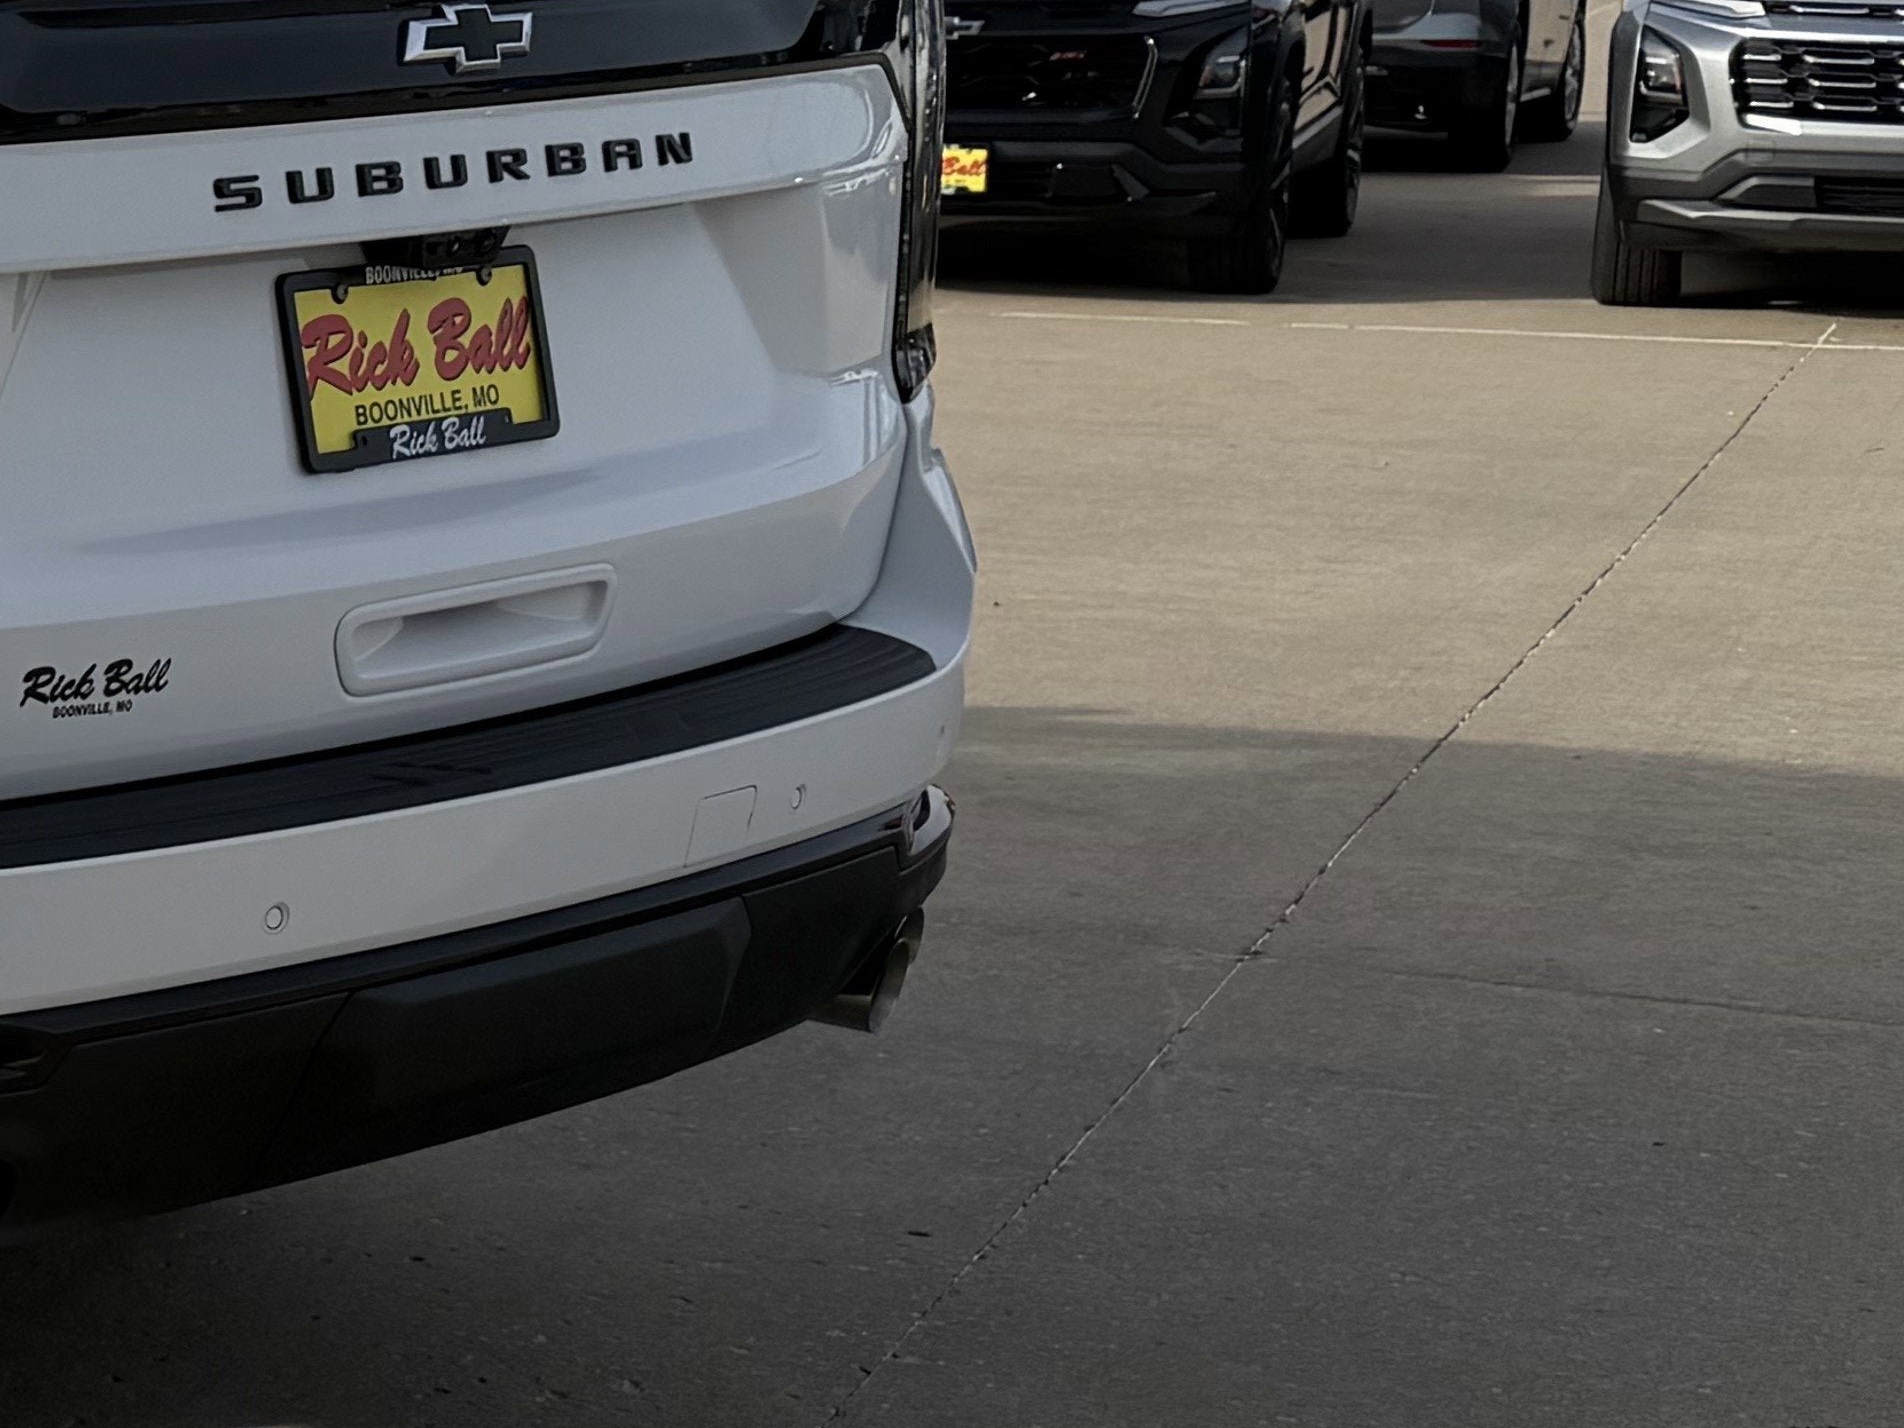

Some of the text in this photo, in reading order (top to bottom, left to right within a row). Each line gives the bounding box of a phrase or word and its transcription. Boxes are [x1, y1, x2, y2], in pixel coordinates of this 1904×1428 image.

[212, 132, 693, 213] SUBURBAN
[301, 296, 531, 401] Rick Ball
[355, 383, 500, 426] BOONVILLE, MO
[390, 416, 487, 460] Rick Ball
[20, 657, 172, 707] Rick Ball
[52, 698, 133, 719] BOONVILLE, MO
